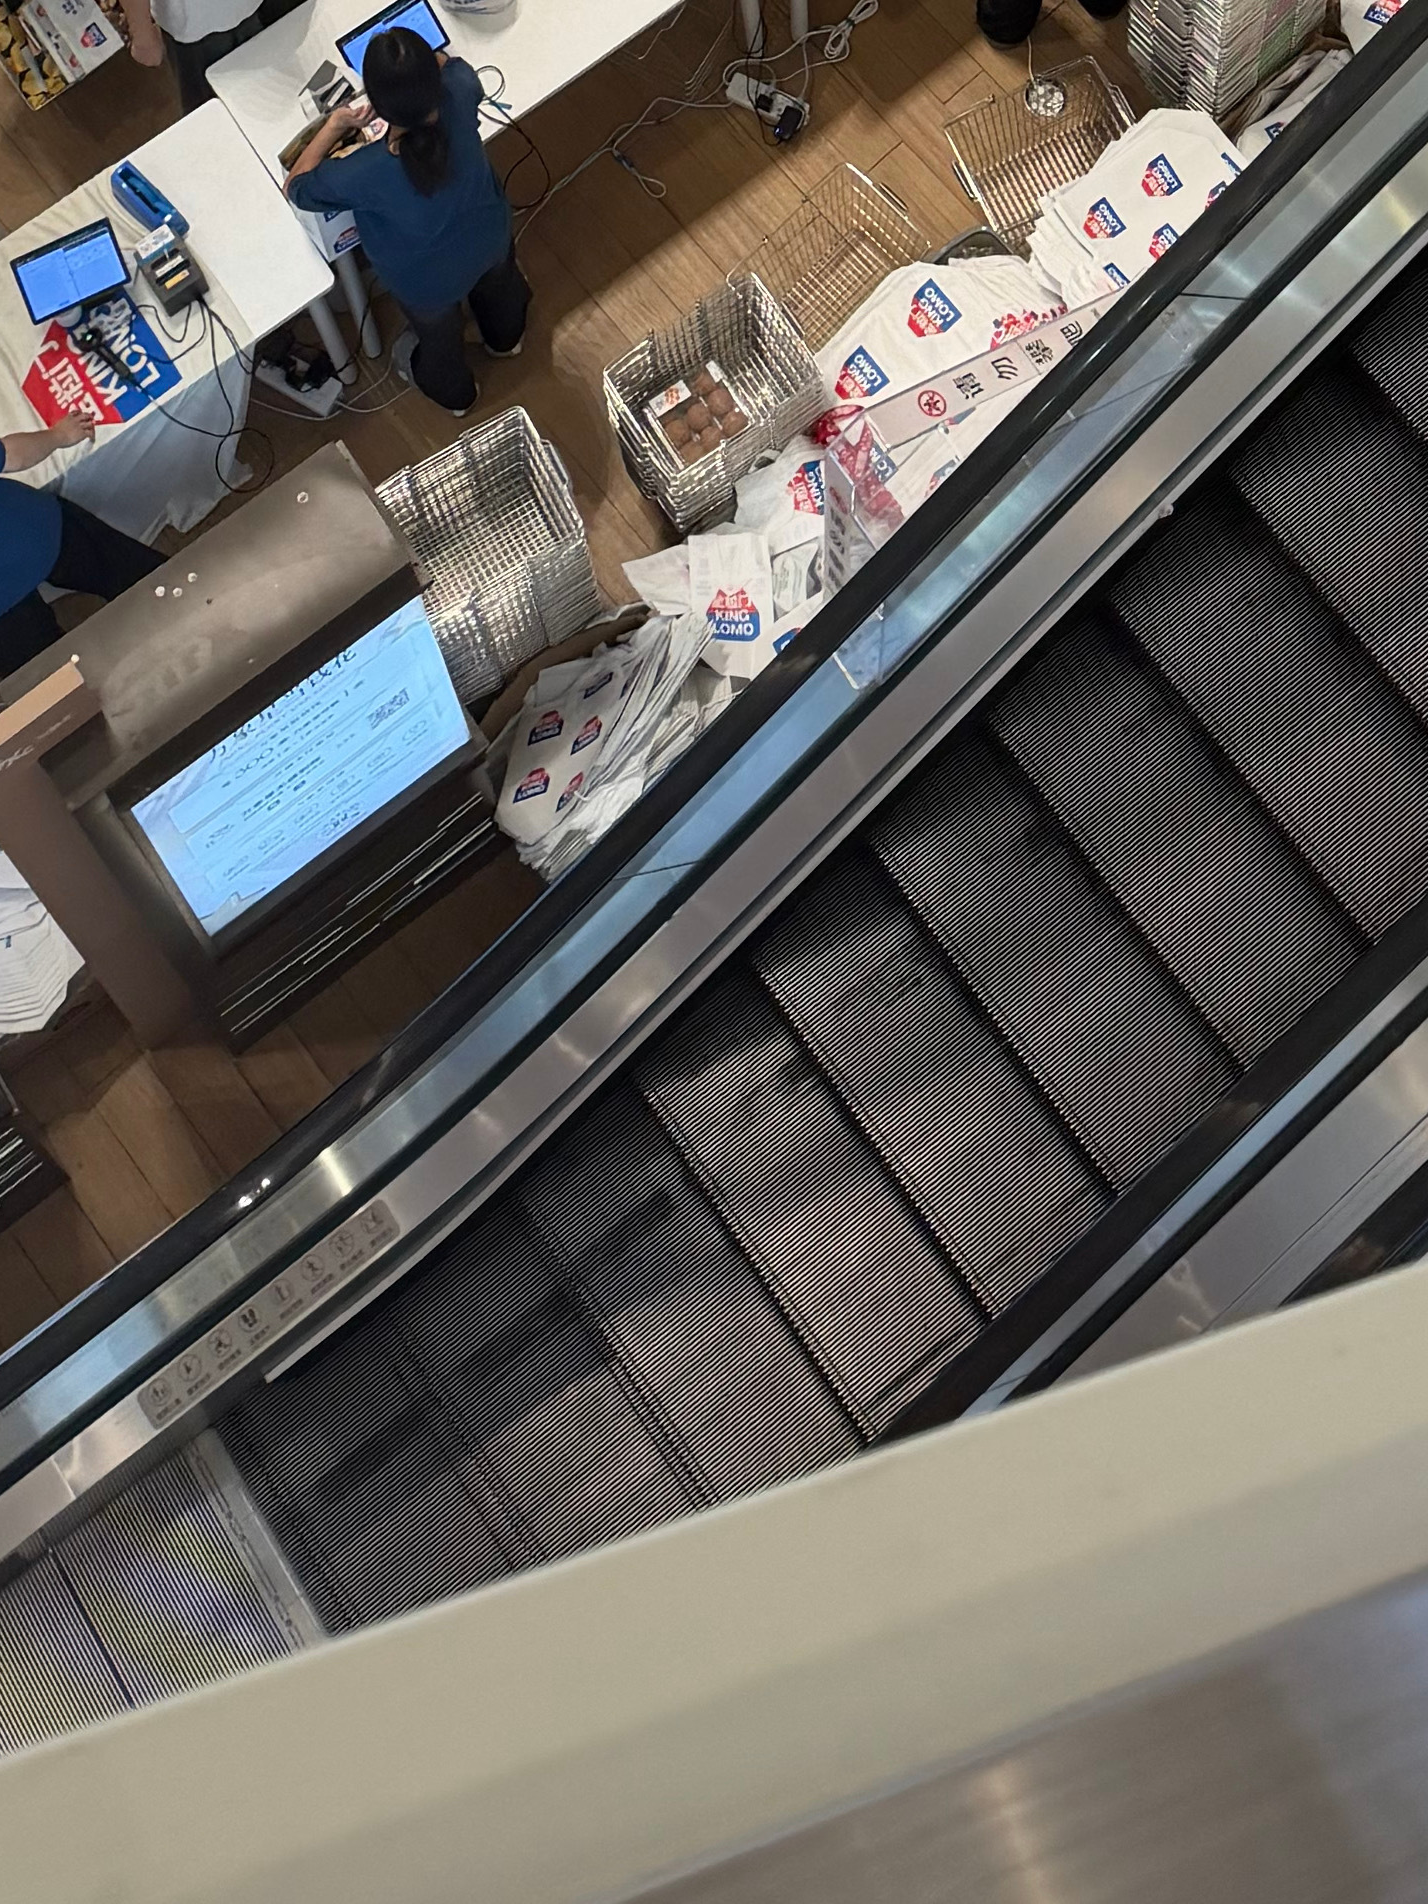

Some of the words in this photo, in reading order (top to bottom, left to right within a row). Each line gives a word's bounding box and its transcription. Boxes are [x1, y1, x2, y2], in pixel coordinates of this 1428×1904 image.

[918, 297, 945, 331] KING
[924, 286, 959, 321] LOMO
[855, 353, 887, 388] LOMO
[714, 610, 750, 623] KING
